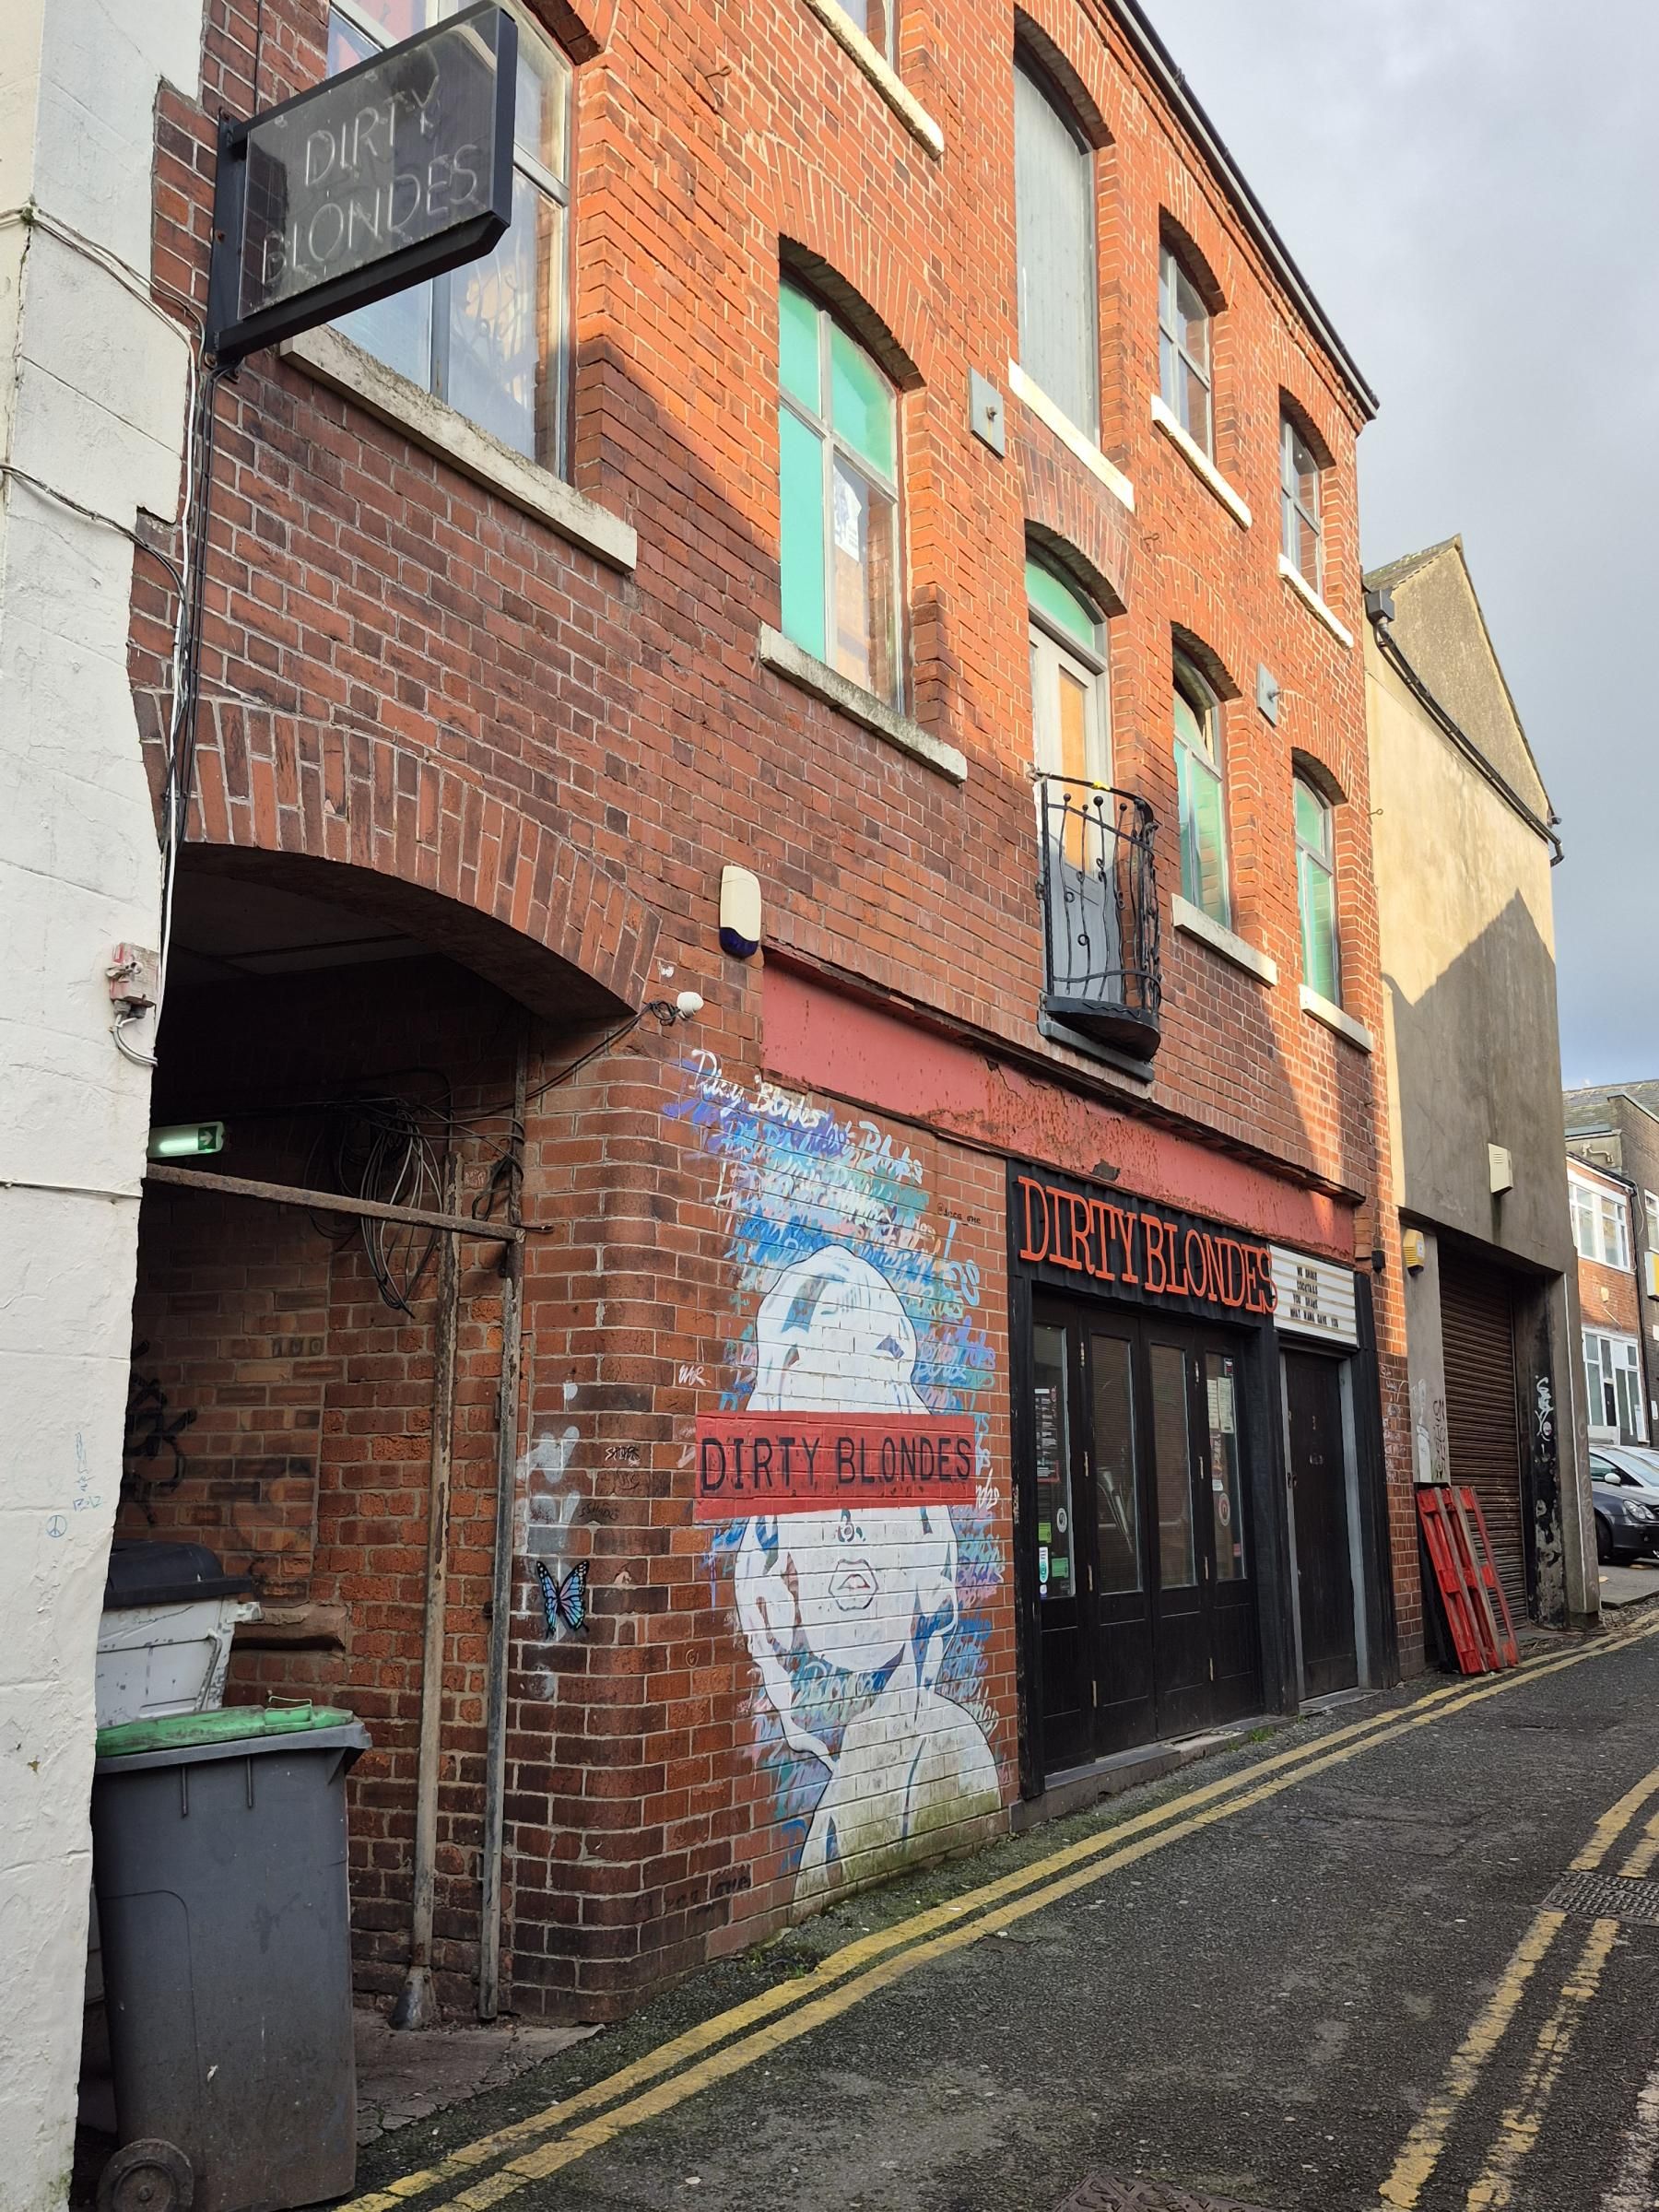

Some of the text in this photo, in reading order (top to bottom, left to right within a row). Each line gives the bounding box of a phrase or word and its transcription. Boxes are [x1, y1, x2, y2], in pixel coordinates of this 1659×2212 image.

[305, 76, 440, 187] DIRTY
[262, 144, 479, 285] BLONDES
[1018, 1175, 1138, 1284] DIRTY
[1140, 1213, 1277, 1314] BLONDES
[700, 1437, 819, 1491] DIRTY
[837, 1436, 971, 1485] BLONDES
